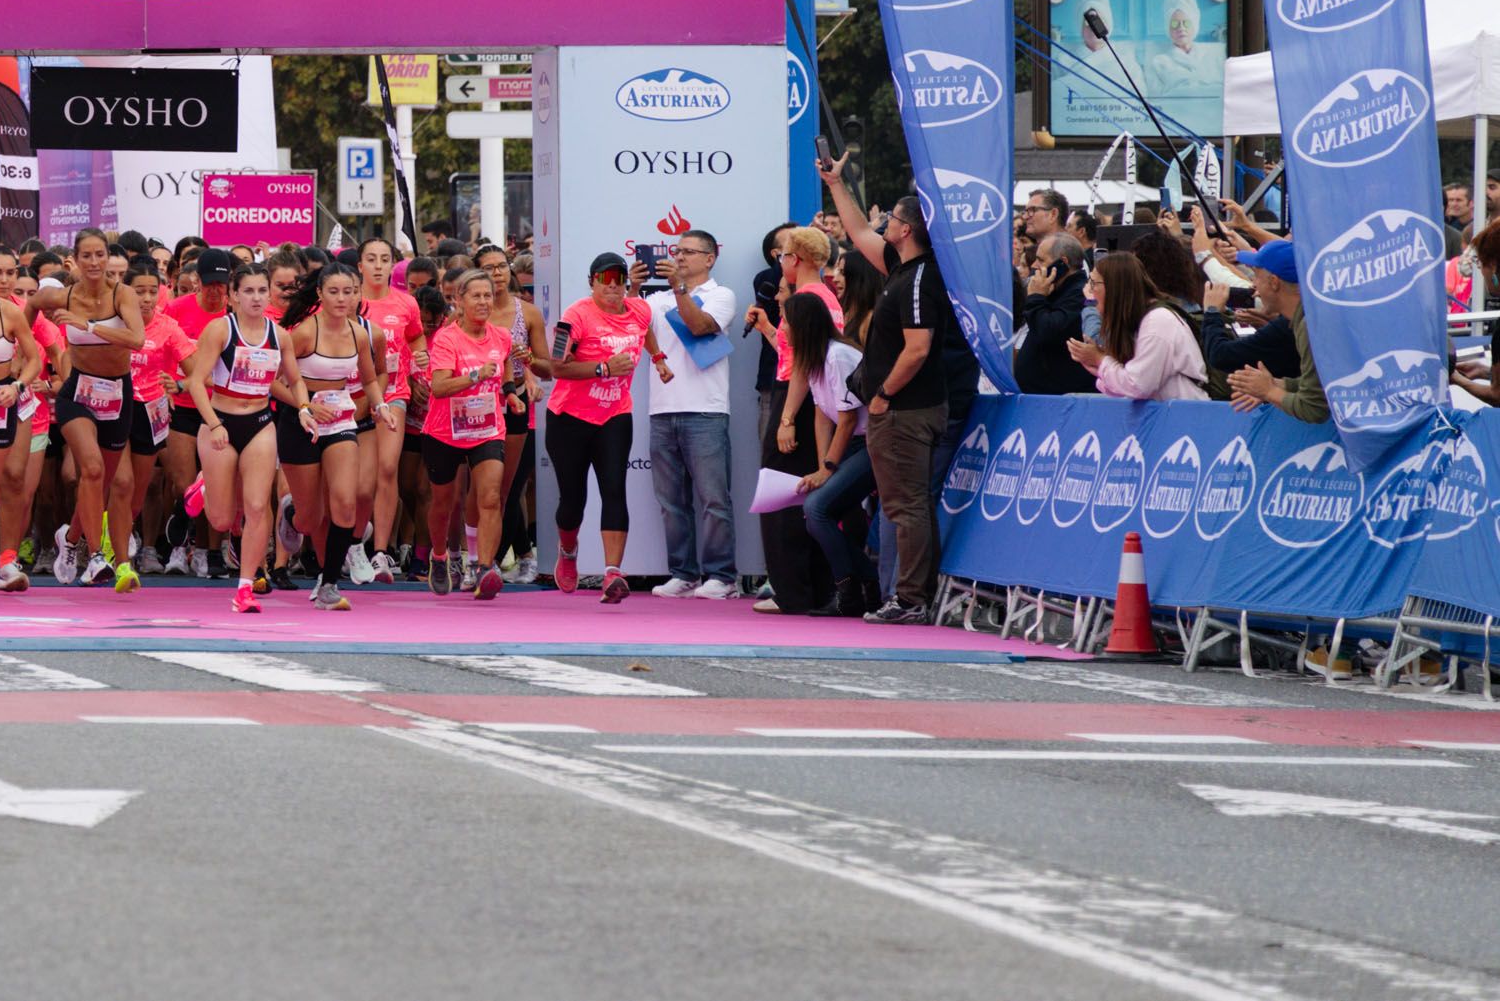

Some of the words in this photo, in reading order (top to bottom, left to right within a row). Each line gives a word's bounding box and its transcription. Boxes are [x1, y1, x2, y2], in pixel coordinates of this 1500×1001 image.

[384, 64, 429, 78] ORRER
[625, 88, 722, 108] ASTURIANA
[64, 96, 208, 127] OYSHO
[614, 150, 733, 175] OYSHO
[267, 183, 311, 194] OYSHO
[204, 207, 312, 223] CORREDORAS
[467, 415, 485, 425] 016
[1264, 477, 1353, 521] ASTURIANA
